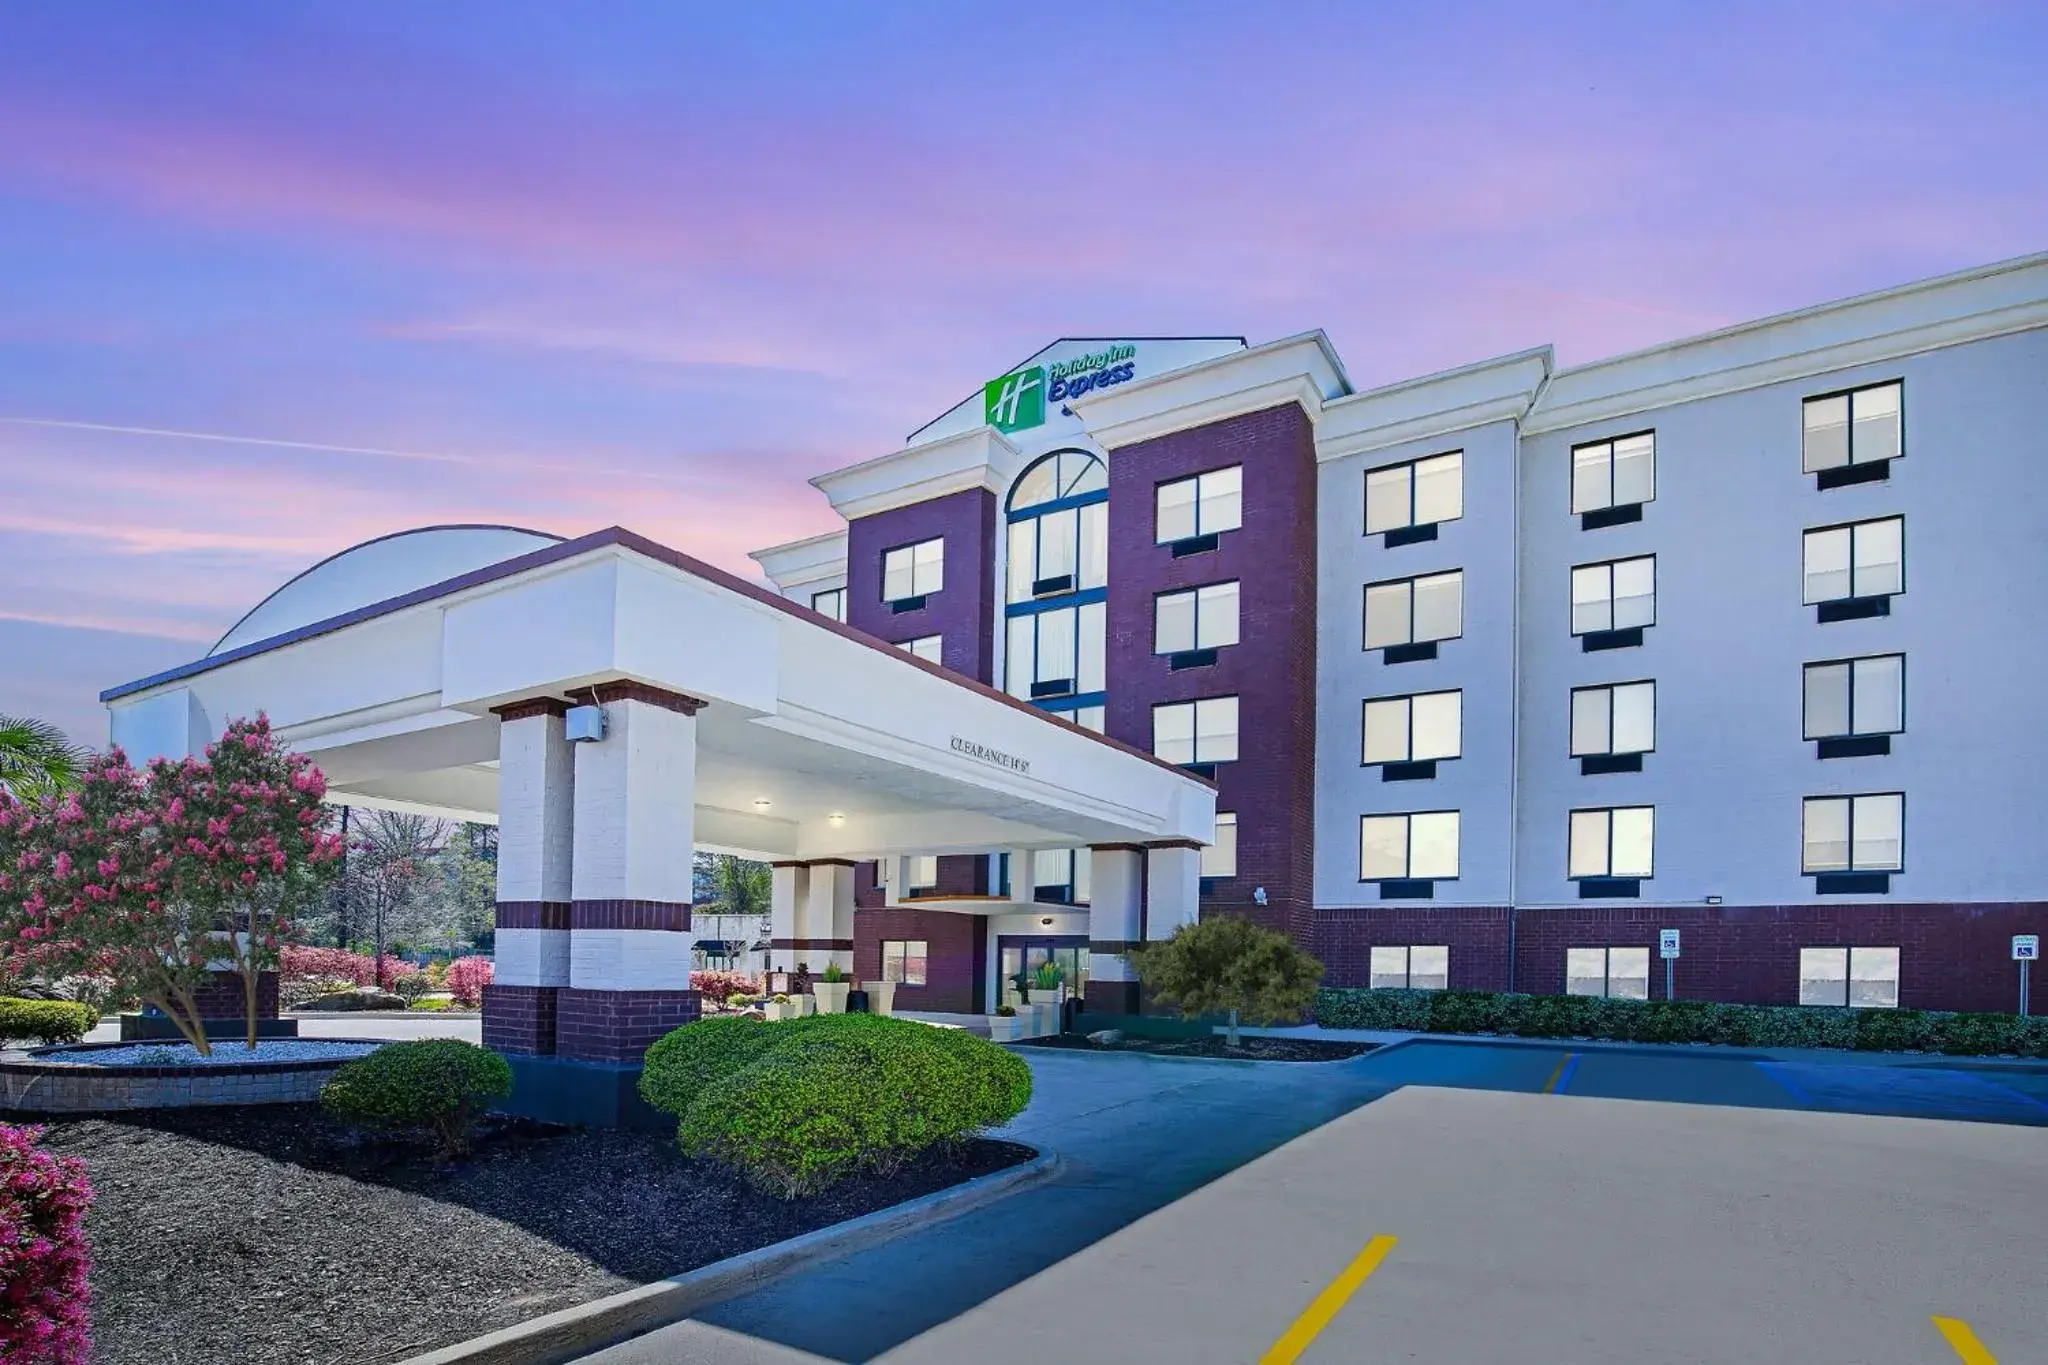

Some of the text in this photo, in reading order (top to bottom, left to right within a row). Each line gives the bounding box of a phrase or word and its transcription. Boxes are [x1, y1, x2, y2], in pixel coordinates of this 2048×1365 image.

[1050, 344, 1136, 378] Holiday Inn
[1048, 362, 1135, 402] Express
[950, 736, 1009, 767] CLEARANCE
